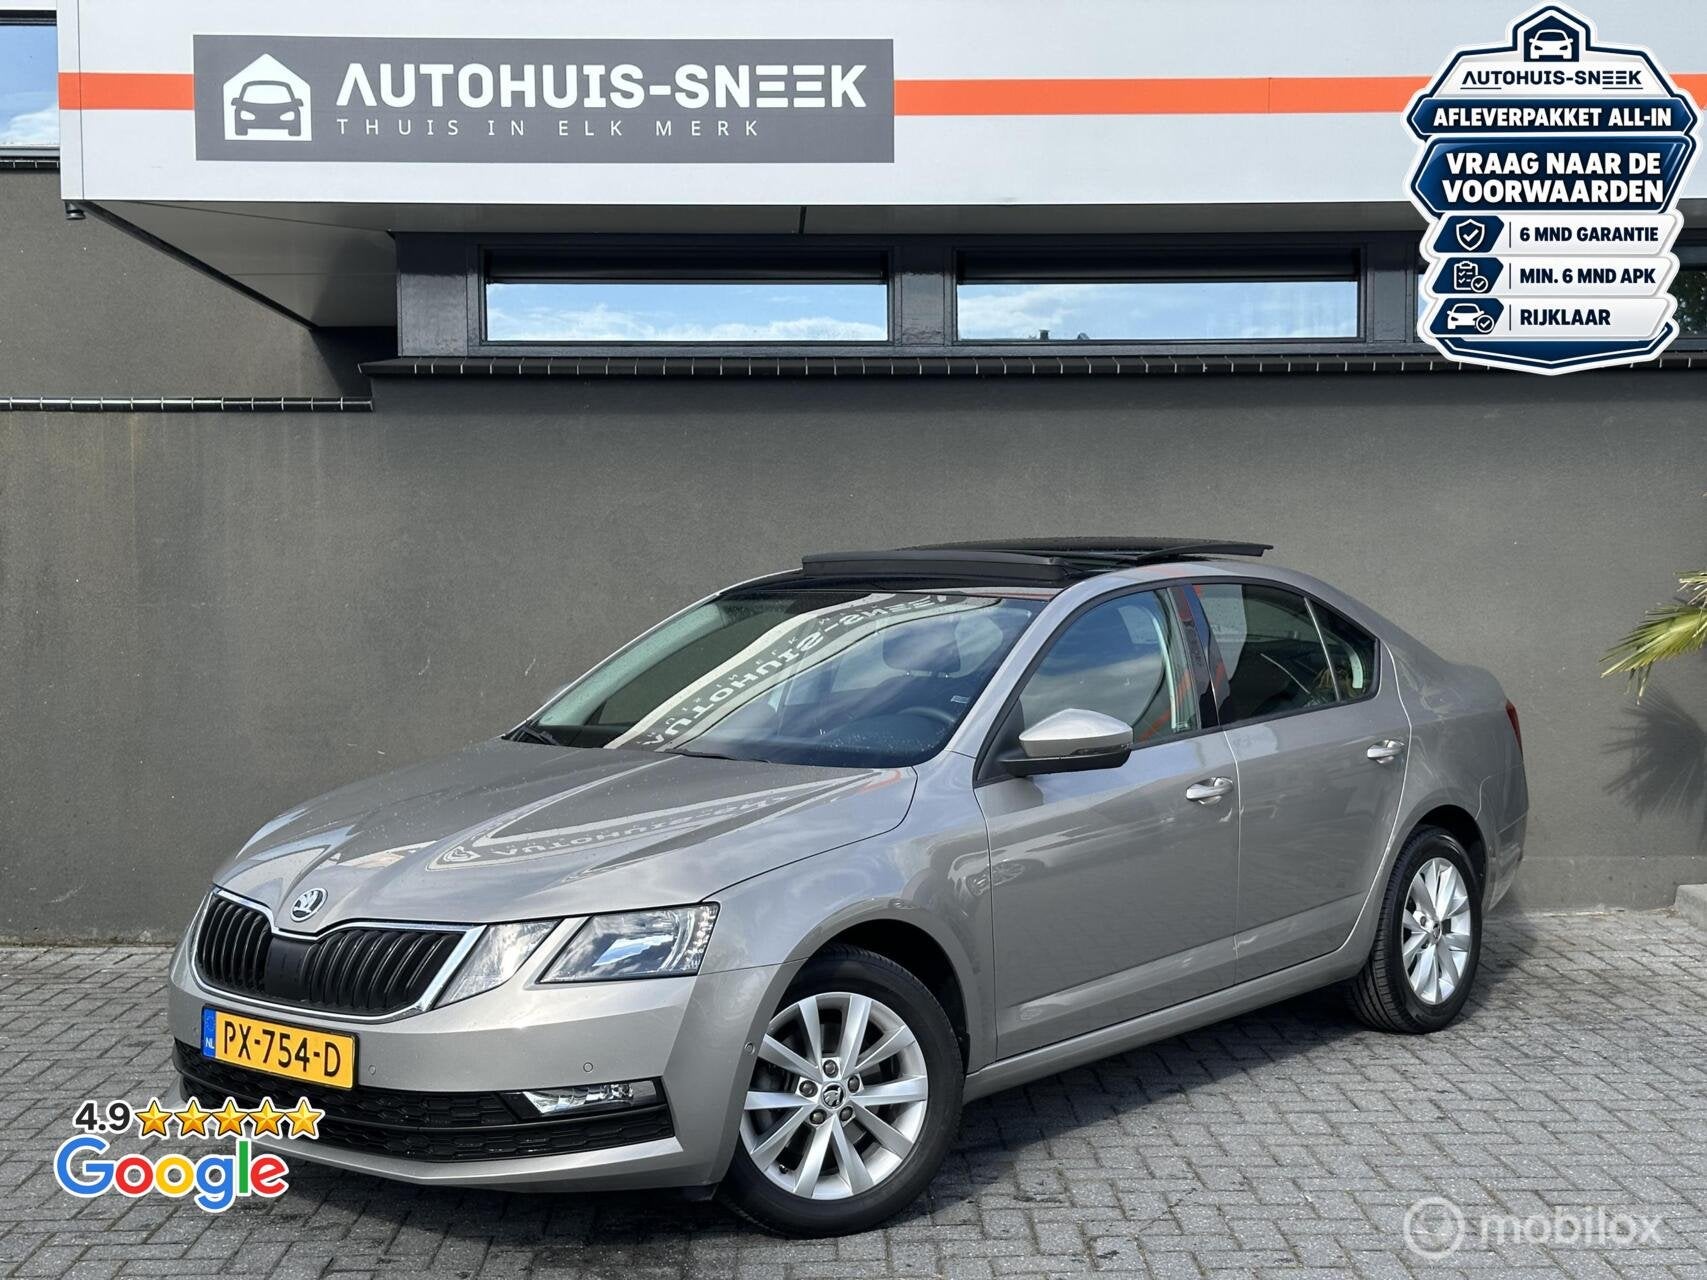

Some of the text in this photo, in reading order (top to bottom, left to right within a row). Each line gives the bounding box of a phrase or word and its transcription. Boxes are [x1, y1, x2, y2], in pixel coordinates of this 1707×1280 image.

[336, 62, 867, 109] AUTOHUIS-SNEEK
[336, 118, 758, 136] THUIS IN ELK MERK
[205, 1020, 341, 1077] NL PX-754-D
